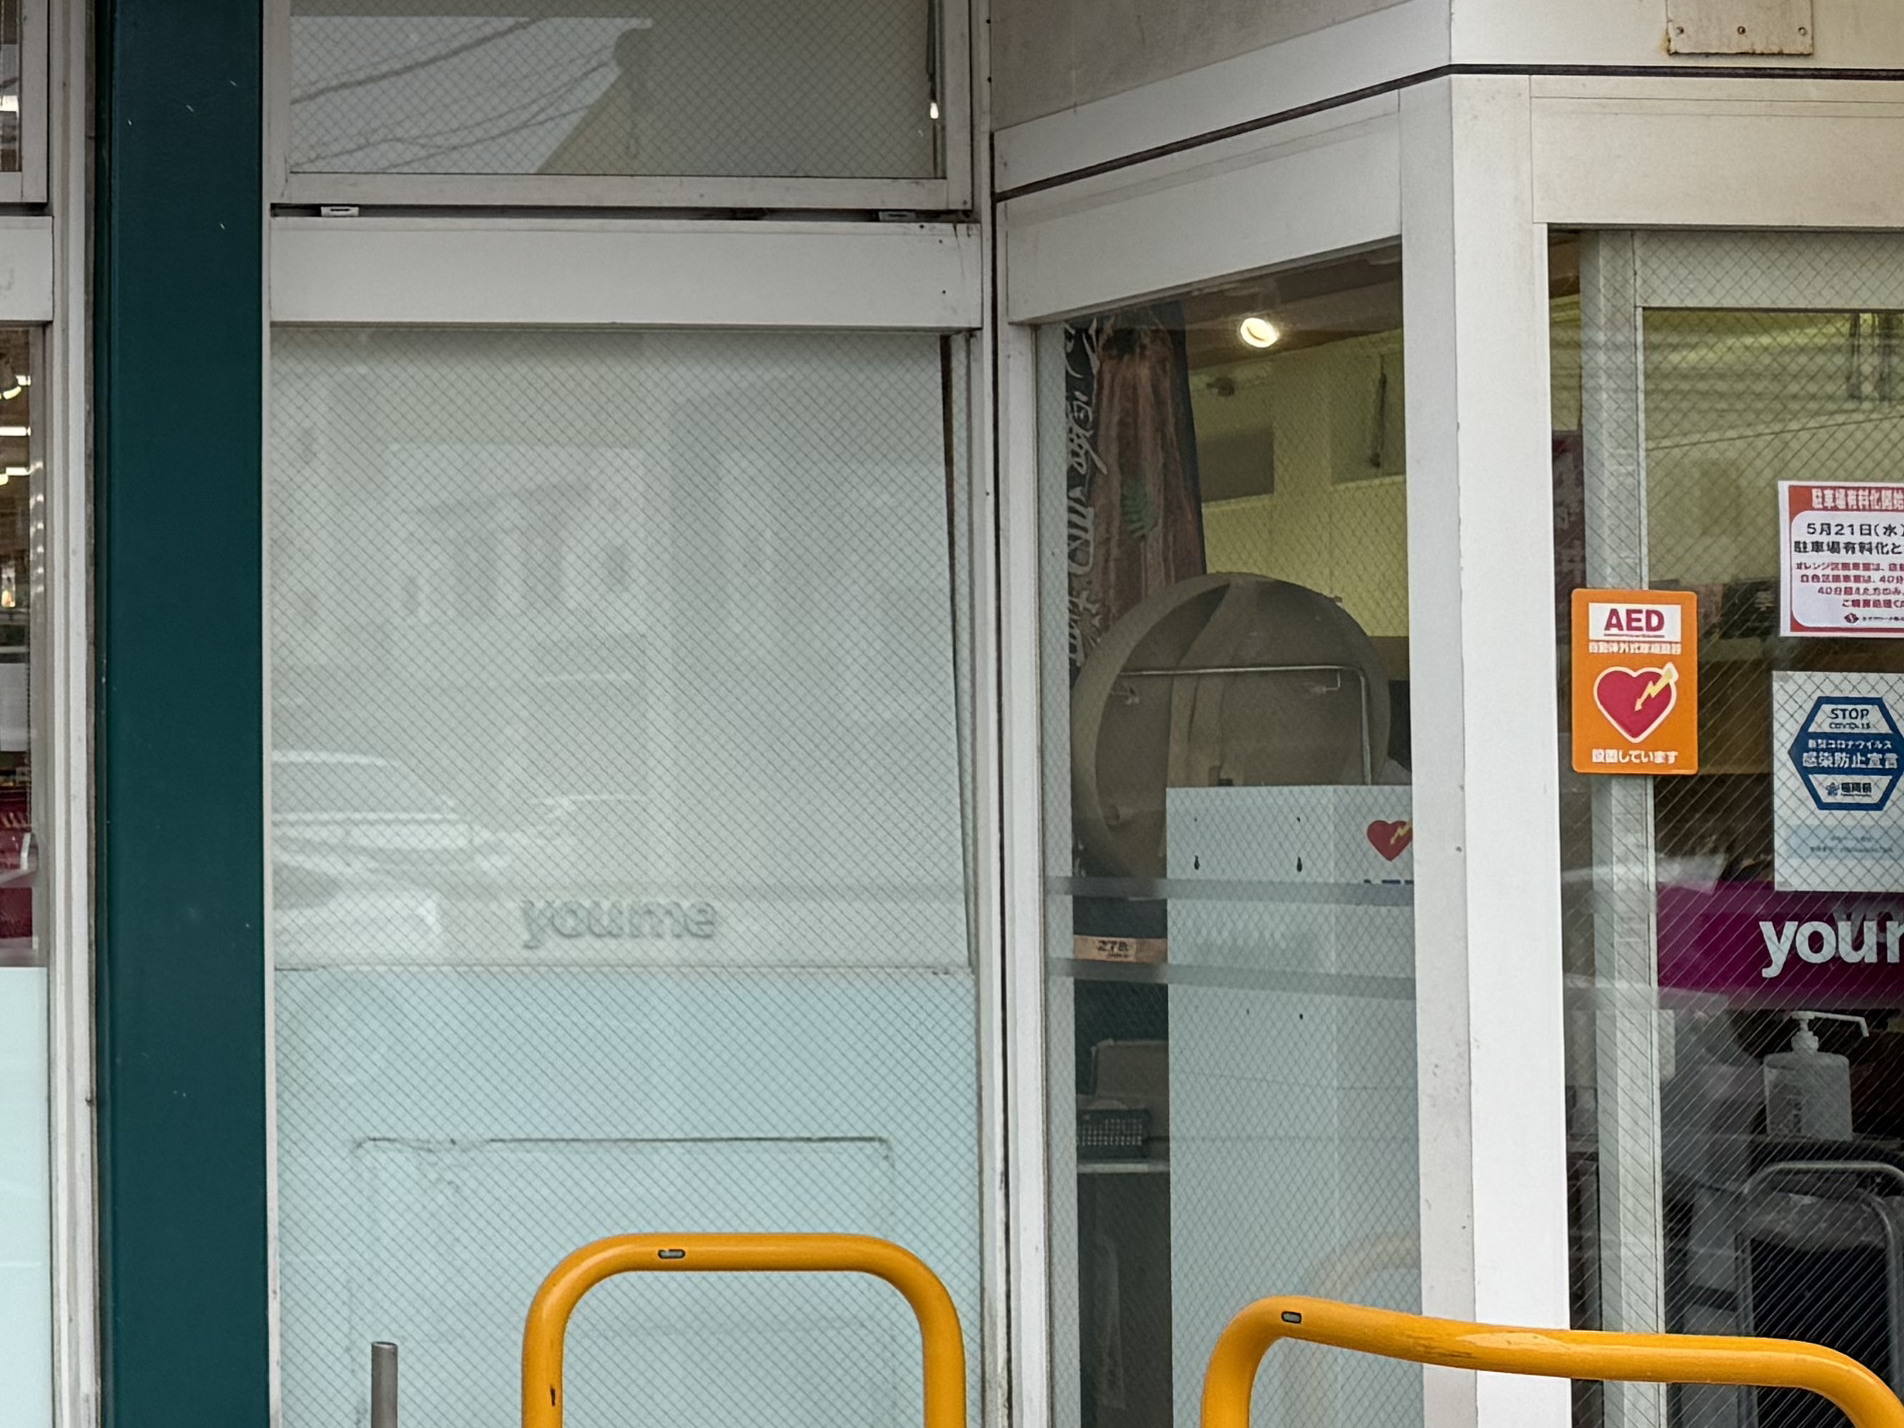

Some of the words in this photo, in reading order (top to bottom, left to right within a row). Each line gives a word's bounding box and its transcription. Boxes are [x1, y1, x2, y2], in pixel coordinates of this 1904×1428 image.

[1603, 608, 1665, 632] AED
[1830, 707, 1870, 720] STOP
[1802, 752, 1899, 769] 感染防止宣言
[522, 900, 717, 950] youme
